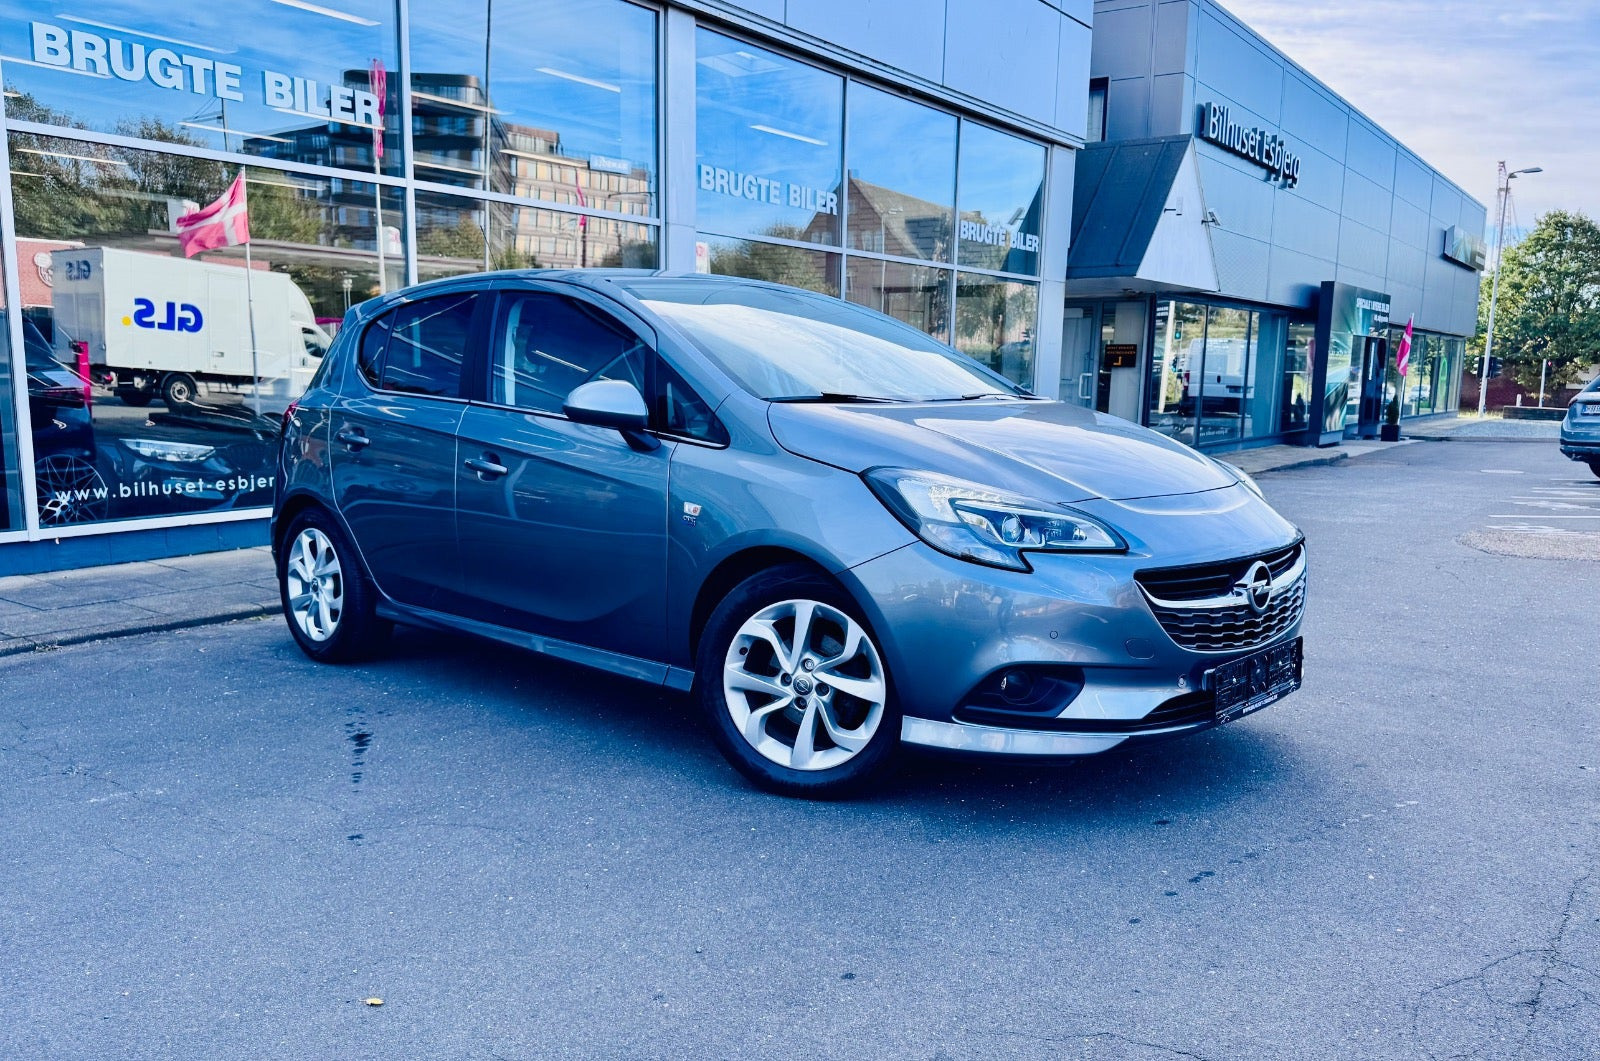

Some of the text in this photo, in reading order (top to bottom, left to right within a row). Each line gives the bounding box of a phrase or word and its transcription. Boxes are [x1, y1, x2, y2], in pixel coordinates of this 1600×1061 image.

[32, 21, 381, 126] BRUGTE BILER
[1208, 102, 1301, 189] Bilhuset Esbjerg
[700, 164, 838, 216] BRUGTE BILER
[960, 219, 1039, 253] BRUGTE BILER
